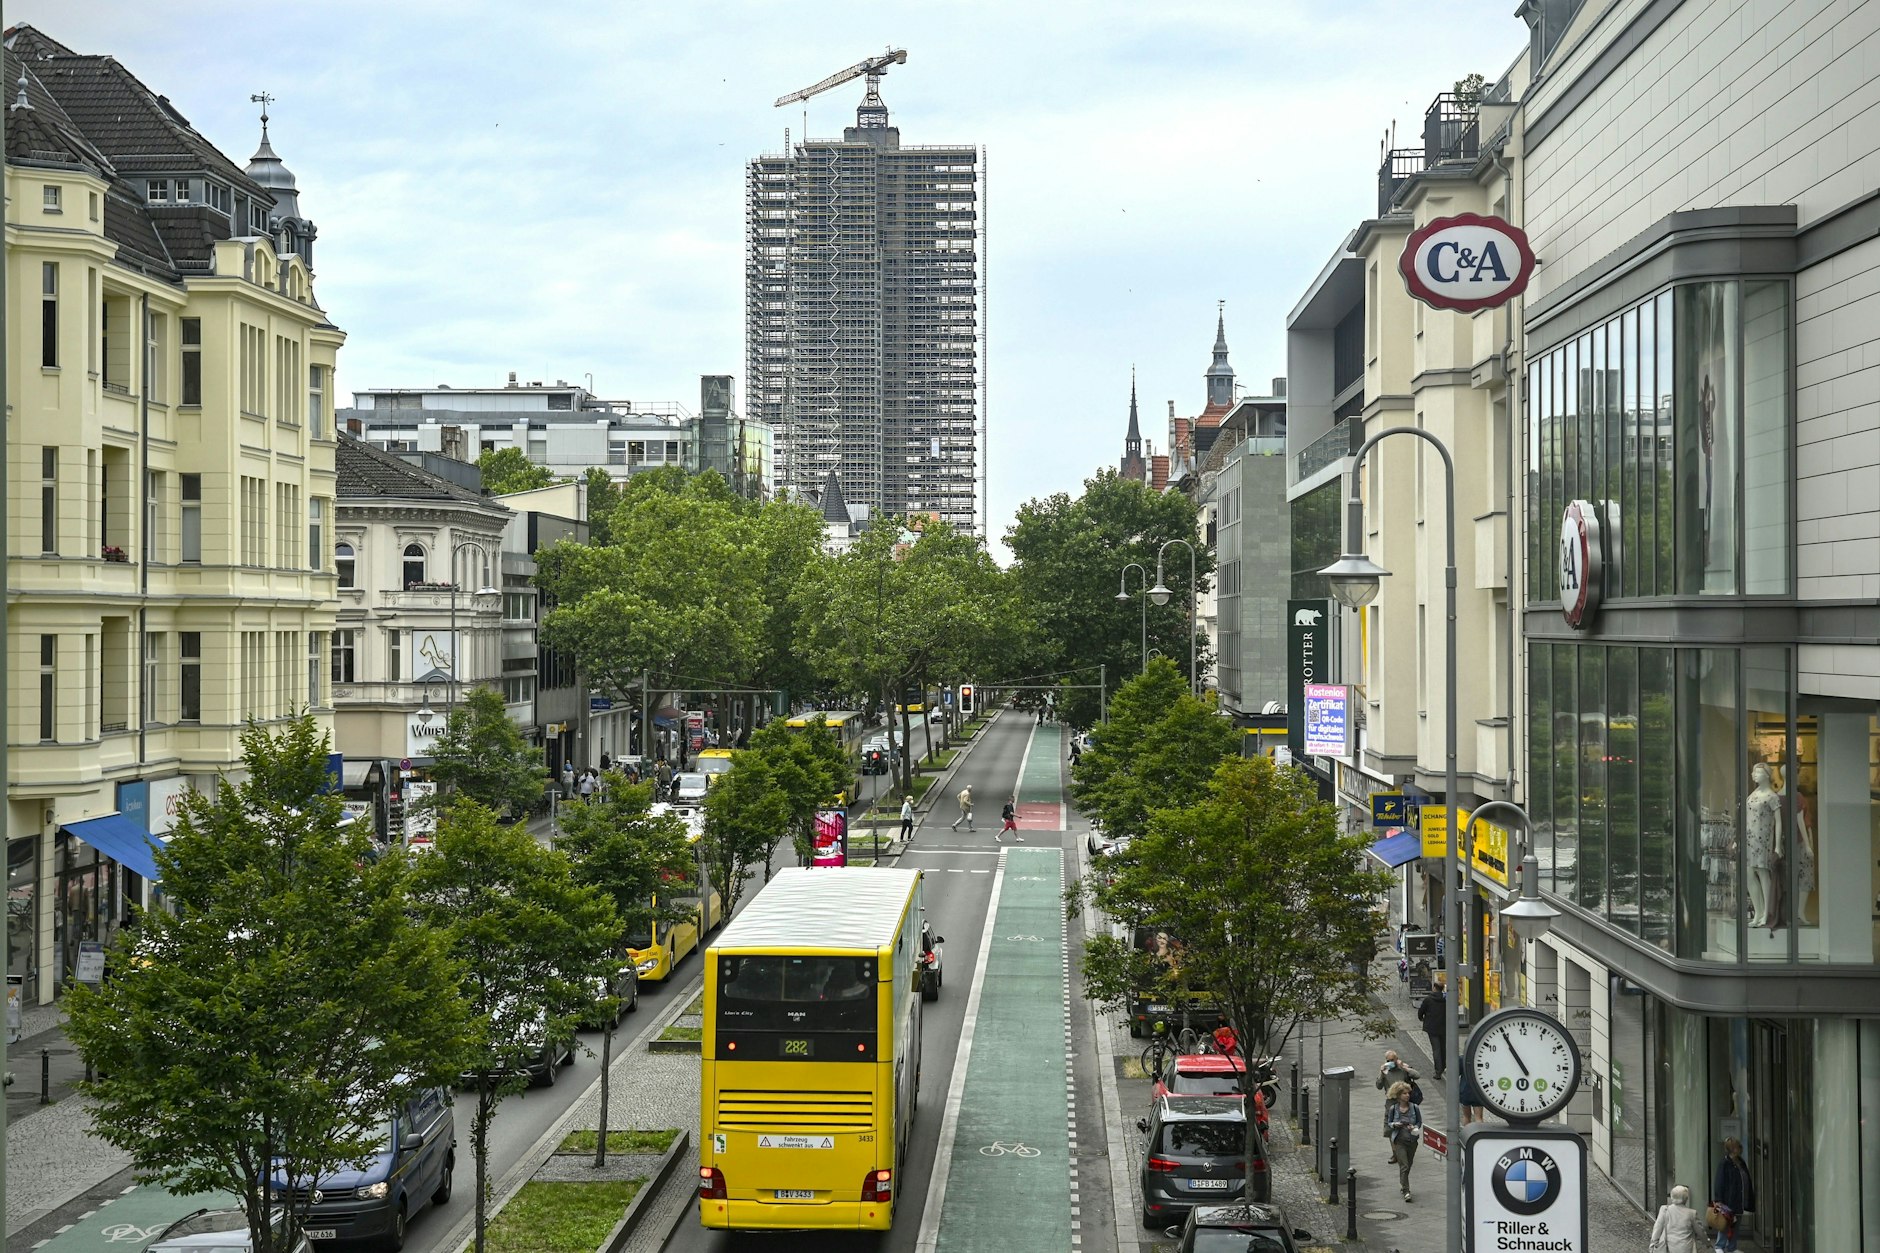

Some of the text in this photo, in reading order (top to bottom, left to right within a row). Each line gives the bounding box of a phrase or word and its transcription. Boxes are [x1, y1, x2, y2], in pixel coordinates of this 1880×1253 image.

[1427, 241, 1510, 283] C&A
[1308, 687, 1344, 697] Kostenlos
[1308, 699, 1344, 710] Zertifikat
[1321, 715, 1344, 724] QR-Code
[1308, 723, 1344, 736] für digitalen
[1519, 1028, 1528, 1036] 12
[785, 1041, 807, 1054] 282
[1489, 1045, 1497, 1053] 10
[1552, 1047, 1557, 1055] 2
[1485, 1062, 1490, 1070] 9
[1556, 1064, 1561, 1072] 3
[1489, 1079, 1494, 1087] 8
[1520, 1098, 1525, 1106] 6
[1538, 1094, 1543, 1102] 5
[784, 1136, 808, 1144] Fahrzeug
[1497, 1148, 1556, 1171] BMW
[795, 1190, 812, 1198] 3433
[1497, 1221, 1550, 1235] Riller &
[1497, 1236, 1573, 1251] Schnauck
